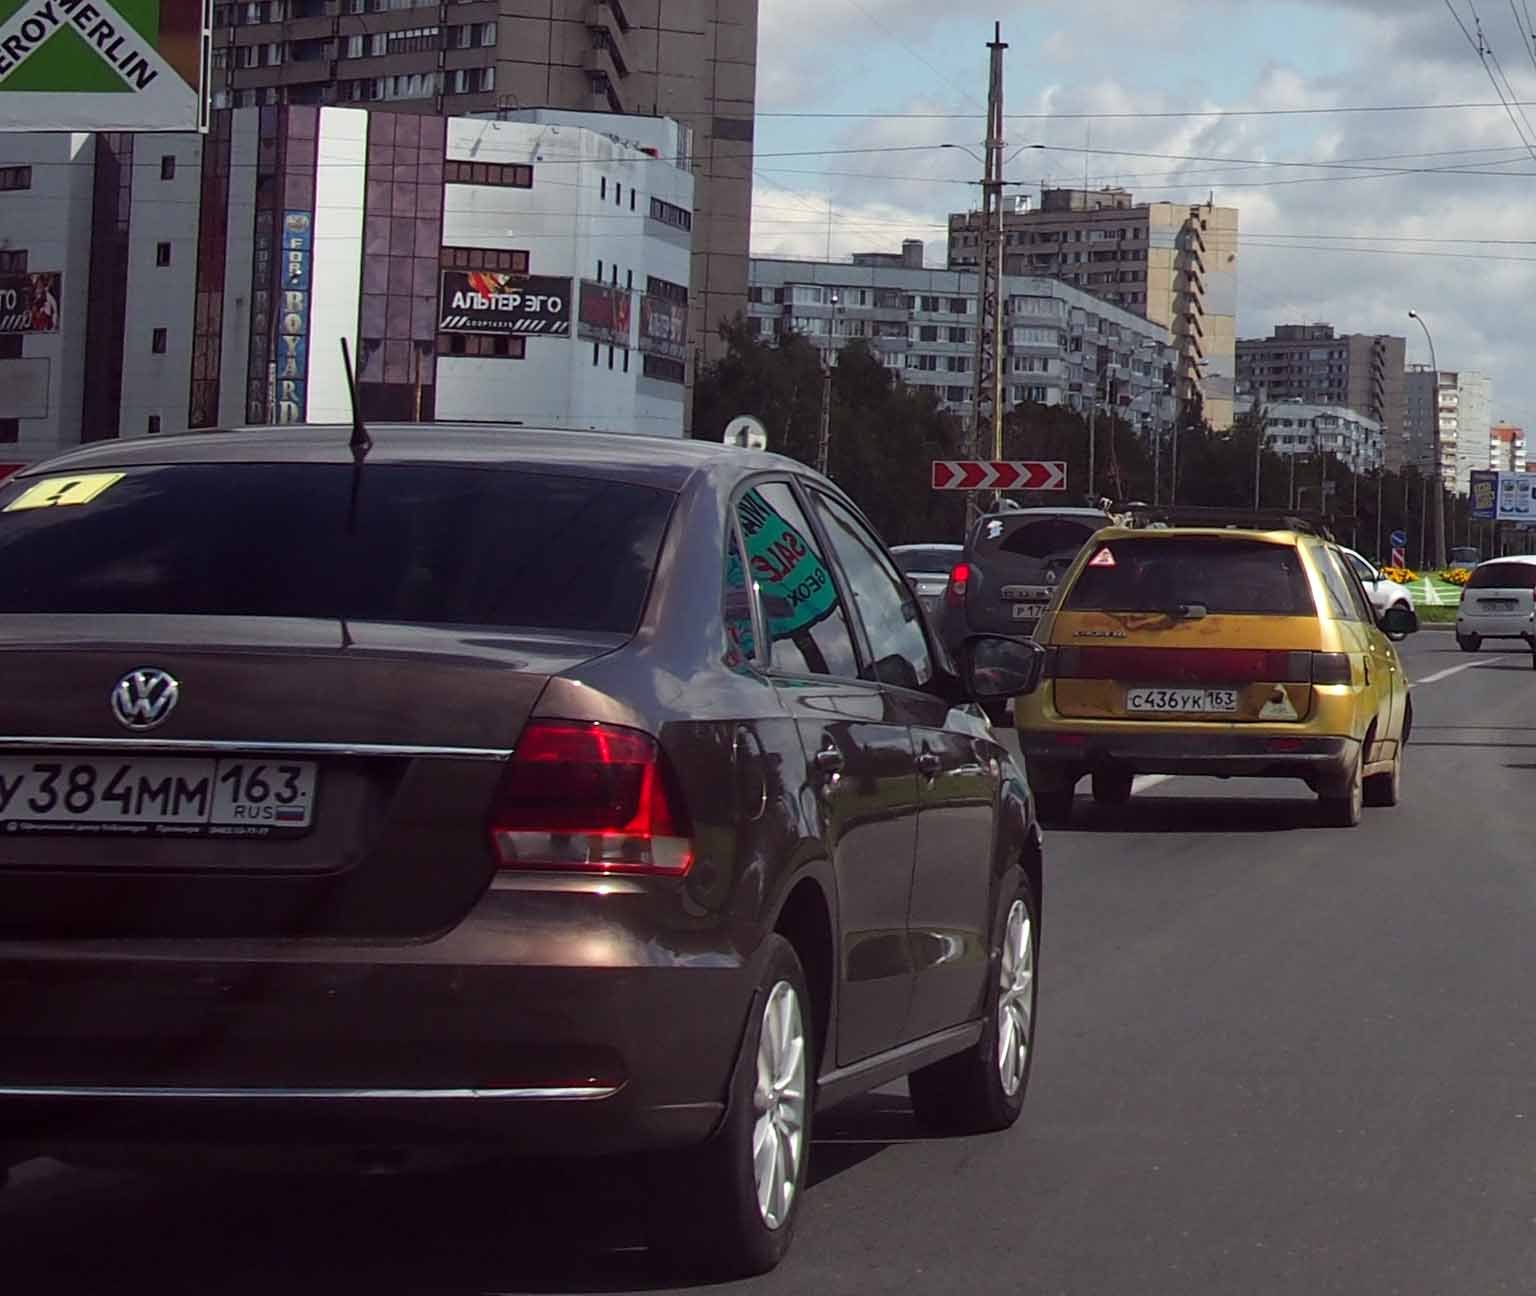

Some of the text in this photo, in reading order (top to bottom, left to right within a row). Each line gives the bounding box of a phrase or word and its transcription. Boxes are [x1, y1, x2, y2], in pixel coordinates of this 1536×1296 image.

[452, 291, 563, 314] АЛЬТЕР ЭГО
[1132, 691, 1234, 709] С436УК 163
[221, 765, 301, 805] 163
[234, 806, 273, 819] RUS
